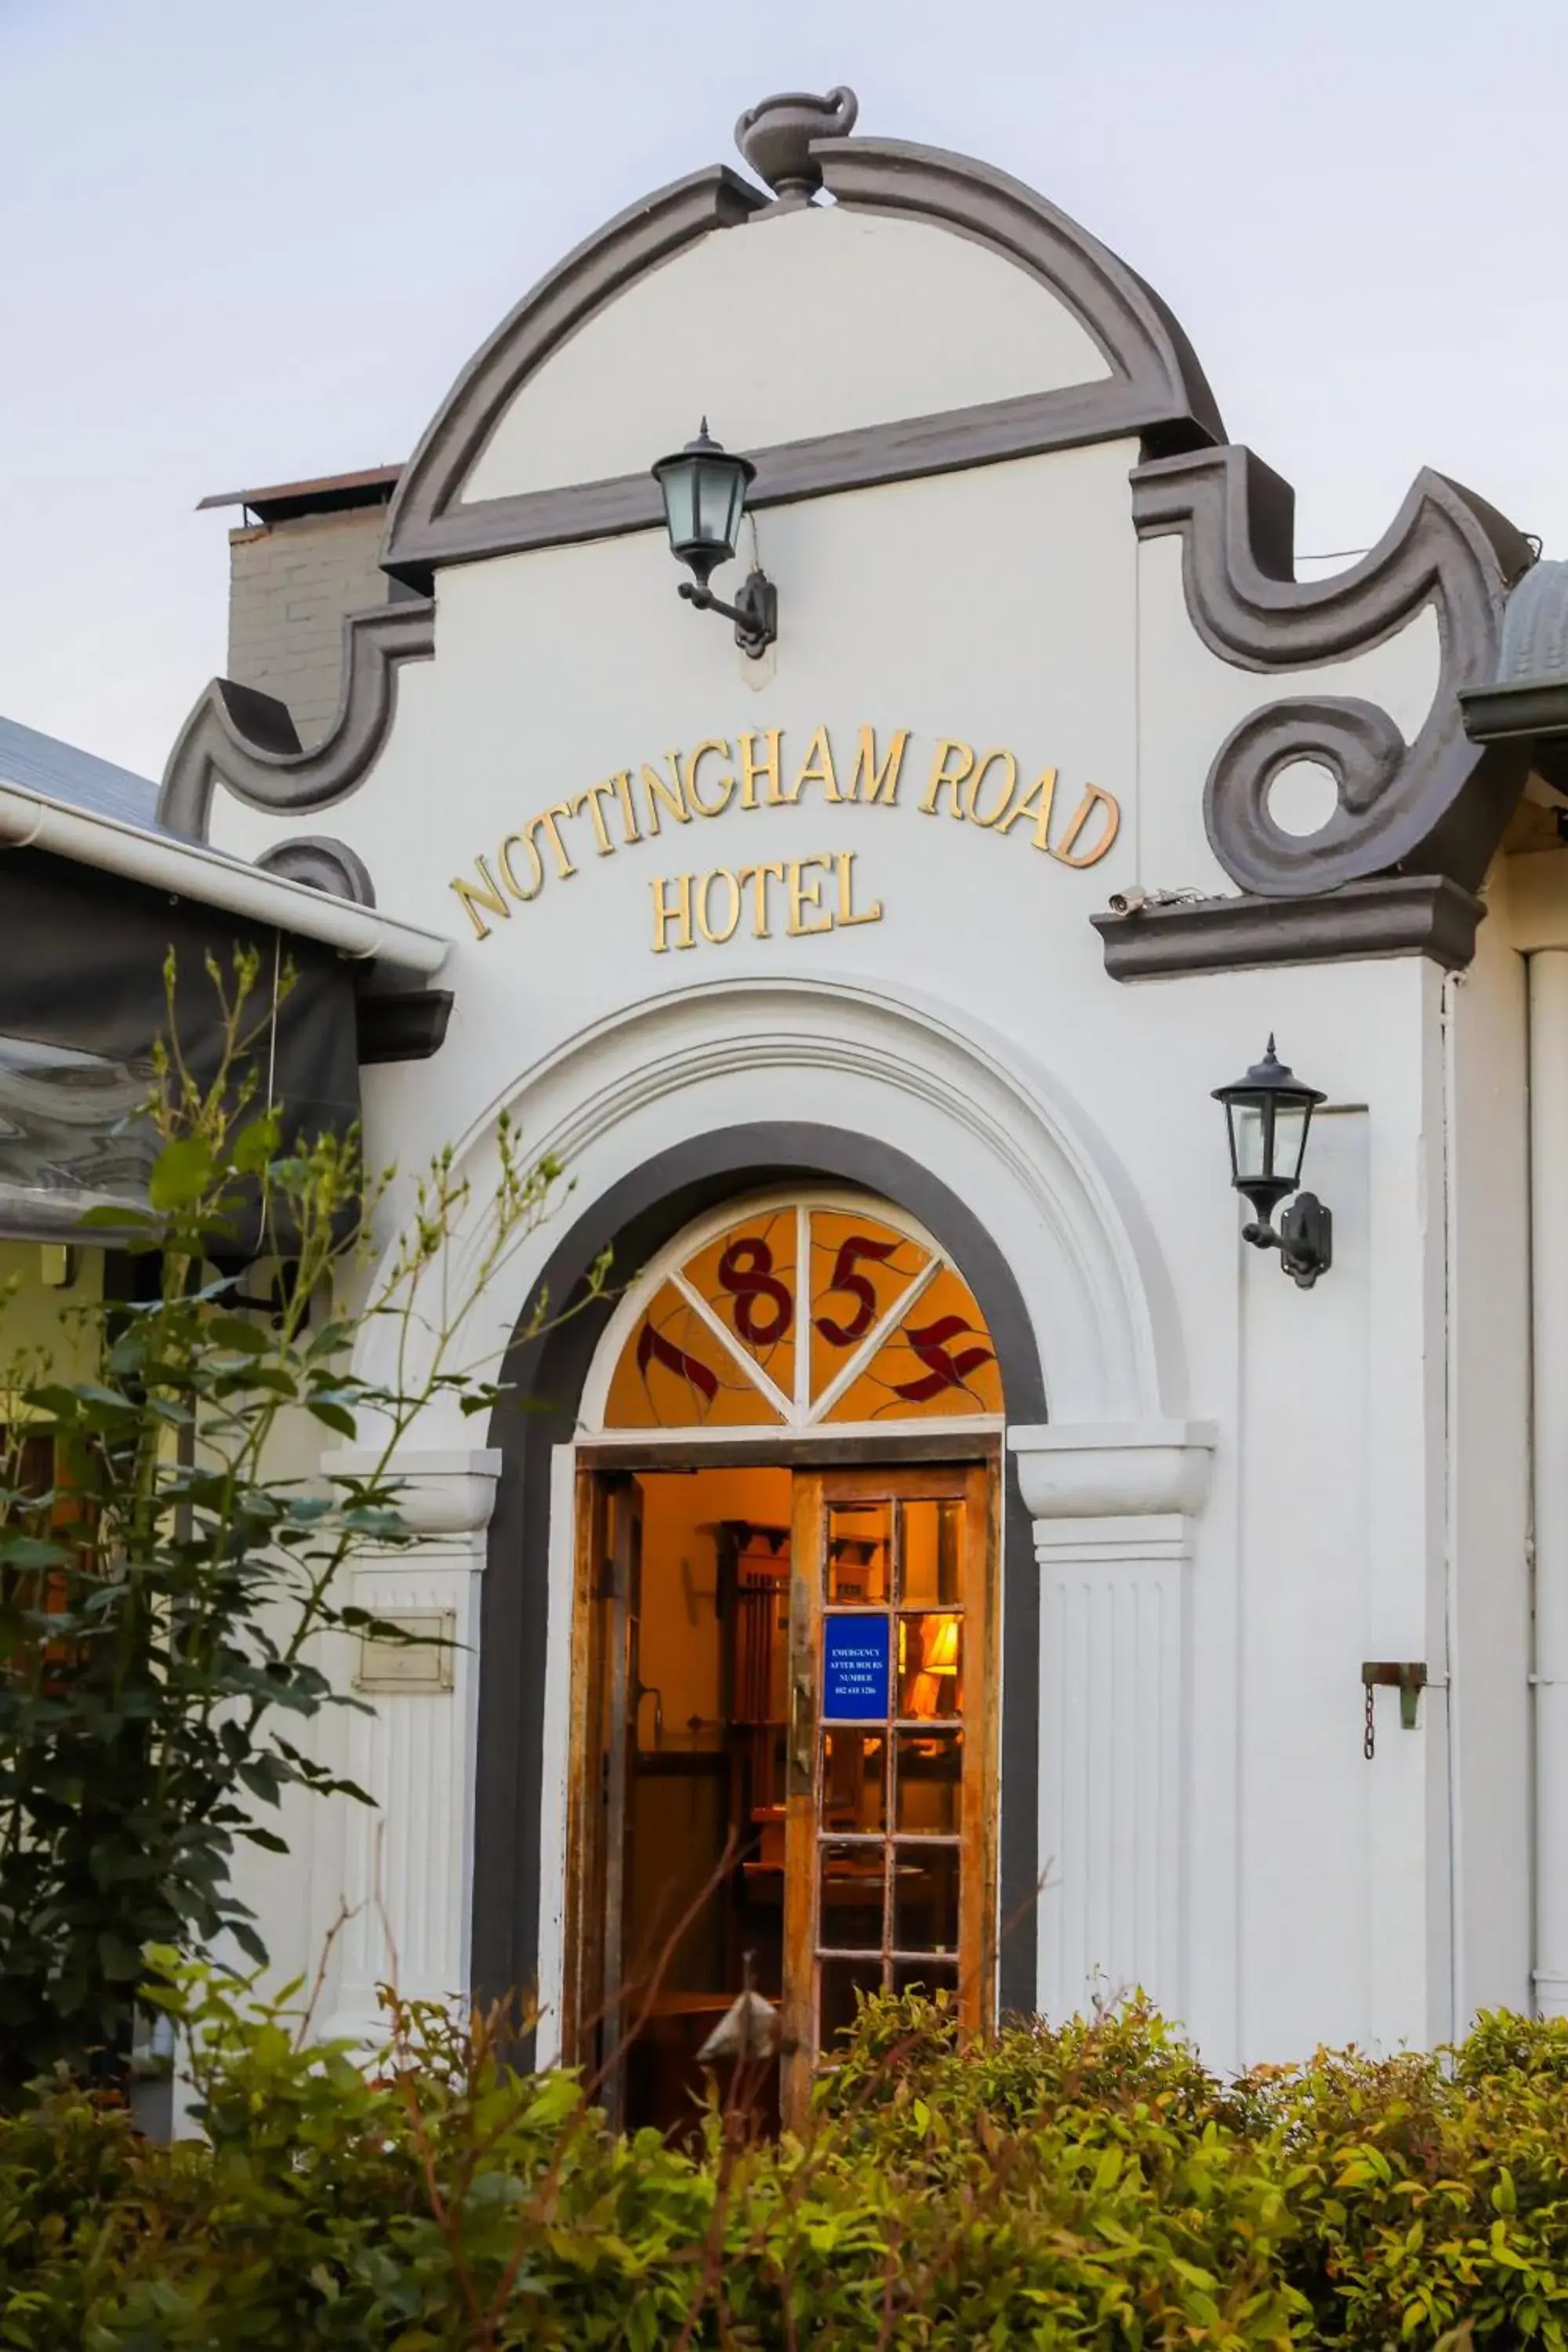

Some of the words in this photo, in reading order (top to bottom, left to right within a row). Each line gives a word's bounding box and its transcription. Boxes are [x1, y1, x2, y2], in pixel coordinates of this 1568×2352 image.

[448, 724, 912, 941] NOTTINGHAM
[919, 739, 1122, 869] ROAD
[648, 851, 883, 953] HOTEL
[830, 1661, 855, 1670] AFTER
[855, 1661, 883, 1670] HOURS
